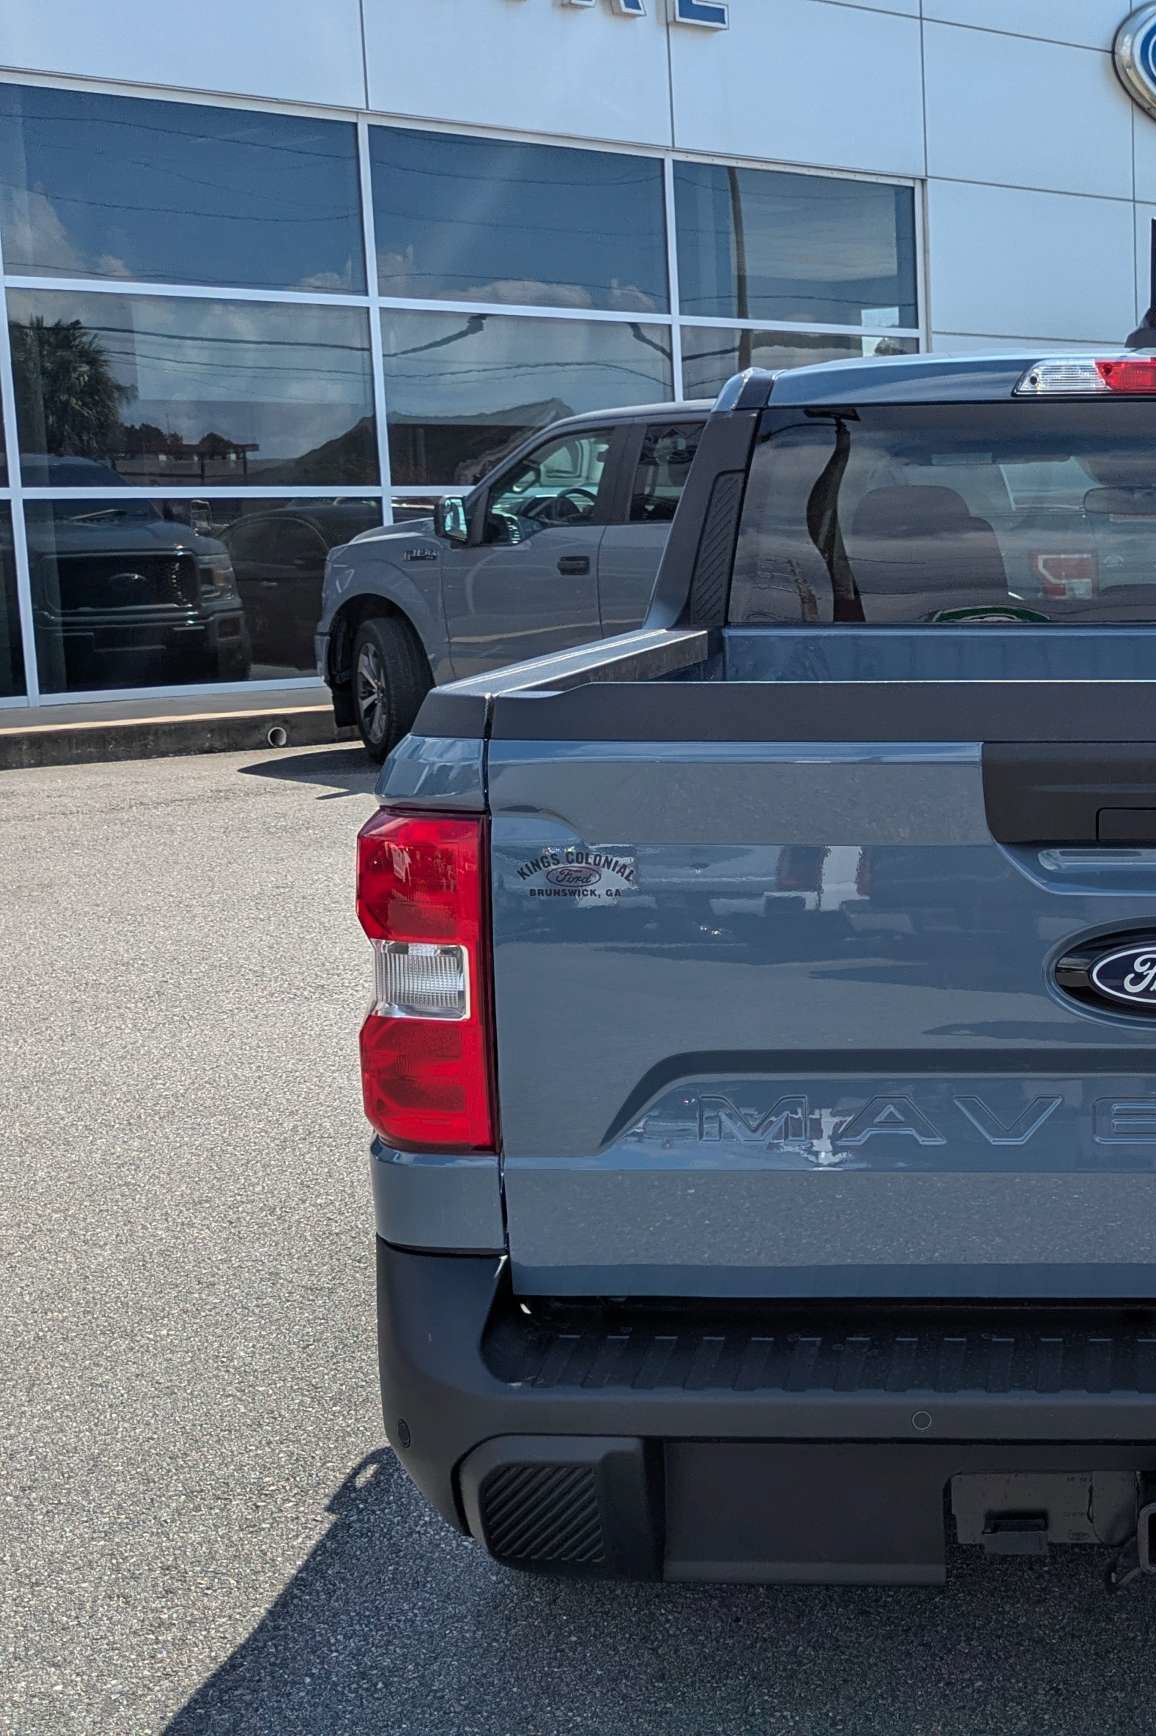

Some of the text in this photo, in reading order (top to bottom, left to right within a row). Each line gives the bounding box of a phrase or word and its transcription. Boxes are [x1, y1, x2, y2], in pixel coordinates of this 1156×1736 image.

[516, 850, 635, 882] KINGS COLONIAL
[555, 868, 593, 884] Ford
[529, 888, 622, 899] BRUNSWICK, GA
